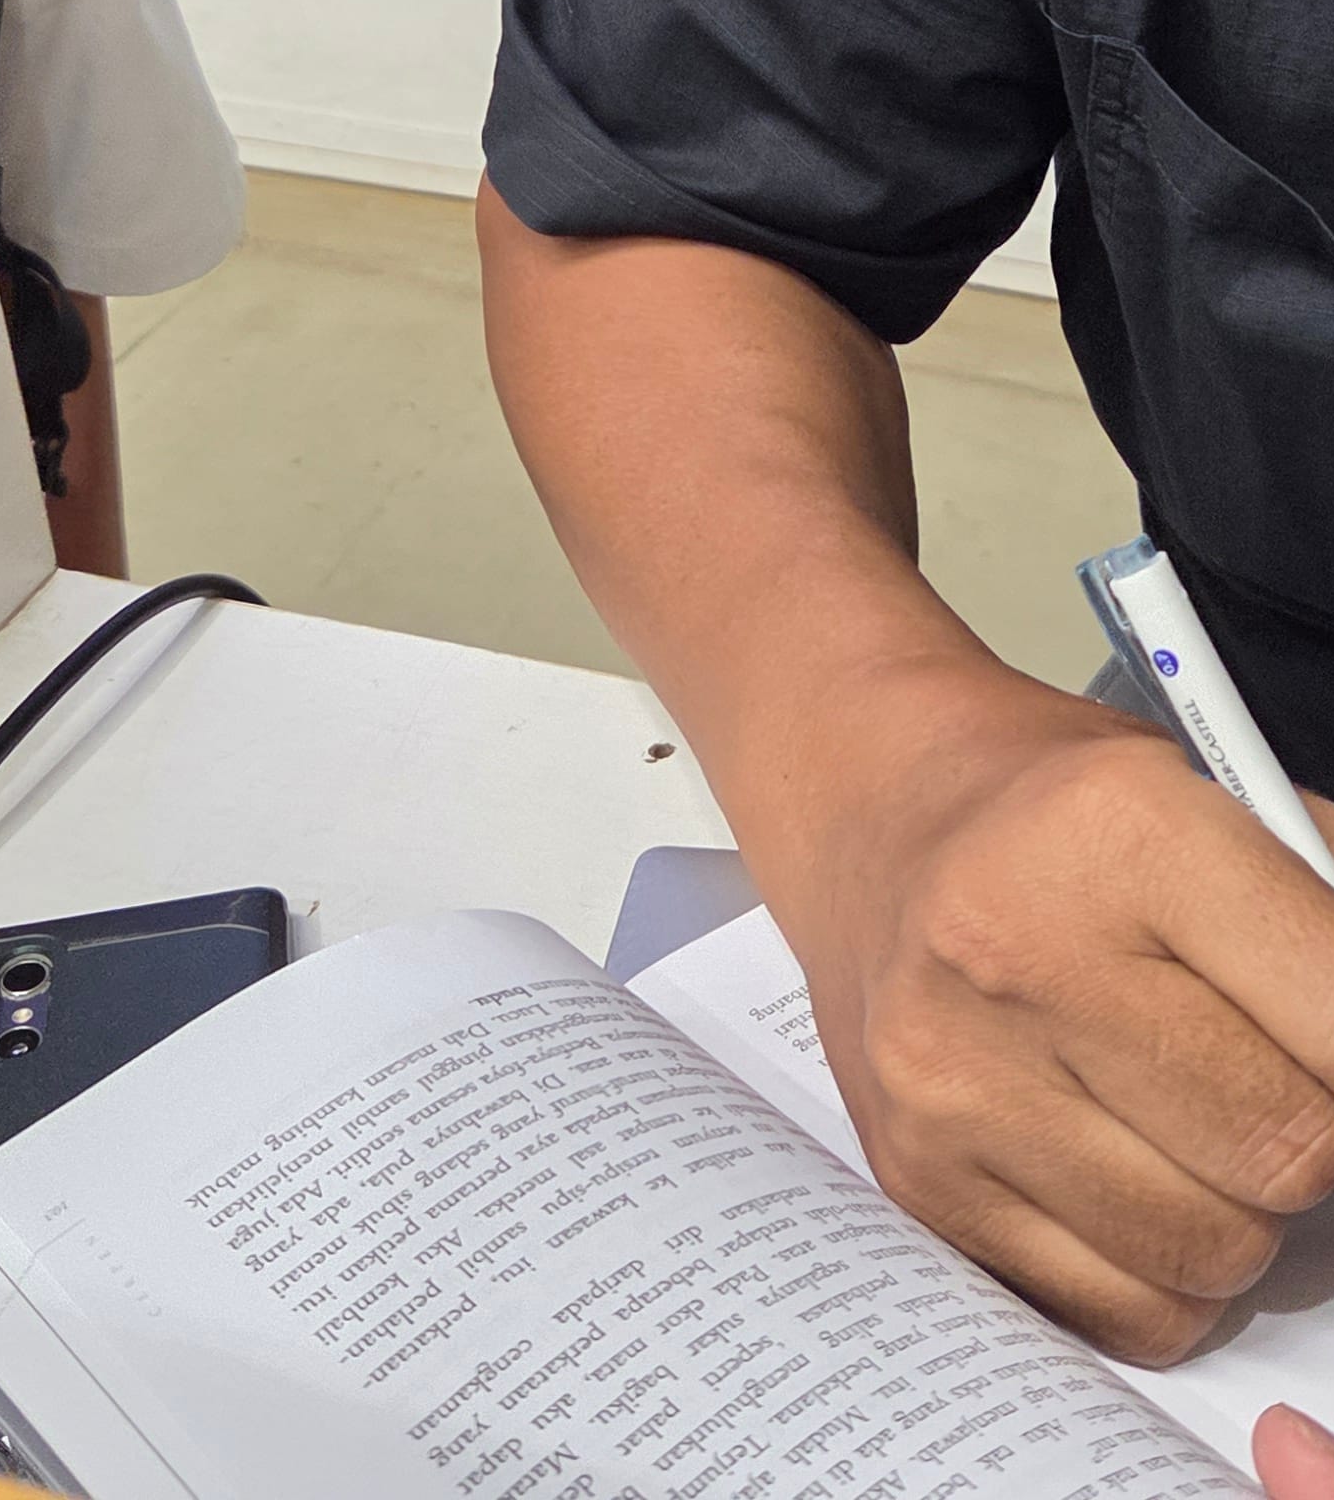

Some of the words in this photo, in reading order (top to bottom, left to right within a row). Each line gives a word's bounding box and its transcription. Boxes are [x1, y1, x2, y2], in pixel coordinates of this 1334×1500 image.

[468, 986, 533, 1007] budu.
[490, 1003, 551, 1023] Lucu.
[441, 1022, 491, 1047] Dah
[363, 1043, 438, 1087] macam
[416, 1042, 493, 1093] pinggul
[479, 1037, 603, 1084] Berfoya-foya
[405, 1082, 478, 1126] sesama
[531, 1073, 567, 1093] Di
[549, 1070, 666, 1119] huruf-huruf
[264, 1087, 365, 1151] kambing
[341, 1088, 410, 1140] sambil
[422, 1089, 530, 1149] bawahnya
[490, 1105, 546, 1141] yang
[563, 1101, 639, 1135] kepada
[616, 1113, 685, 1142] tempat
[692, 1106, 722, 1120] ke
[326, 1124, 405, 1180] sendiri.
[515, 1133, 560, 1162] ayat
[567, 1141, 607, 1170] asal
[671, 1125, 741, 1148] senyum
[184, 1152, 263, 1209] mabuk
[359, 1148, 415, 1188] pula,
[414, 1139, 490, 1188] sedang
[541, 1149, 660, 1215] tersipu-sipu
[644, 1173, 678, 1191] ke
[683, 1147, 754, 1174] melihat
[207, 1137, 333, 1228] menjelirkan
[276, 1178, 323, 1214] Ada
[424, 1155, 512, 1219] pertama
[474, 1167, 557, 1218] mereka.
[720, 1186, 811, 1220] melarikan
[226, 1207, 280, 1250] juga
[309, 1196, 351, 1226] ada
[351, 1189, 413, 1235] sibuk
[545, 1193, 639, 1249] kawasan
[244, 1225, 304, 1273] yang
[337, 1216, 421, 1282] petikan
[413, 1227, 463, 1265] Aku
[455, 1221, 528, 1279] sambil
[663, 1225, 704, 1254] diri
[716, 1217, 798, 1257] terdapat
[771, 1240, 817, 1262] atas.
[822, 1223, 901, 1243] bahagian
[269, 1235, 347, 1299] menari
[490, 1256, 537, 1283] itu,
[711, 1264, 770, 1296] Pada
[756, 1260, 850, 1307] segalanya
[291, 1284, 338, 1313] itu.
[314, 1272, 409, 1346] kembali
[552, 1260, 645, 1324] daripada
[613, 1258, 716, 1321] beberapa
[796, 1270, 898, 1323] peribahasa
[894, 1290, 964, 1317] Setelah
[340, 1277, 442, 1363] perlahan-
[655, 1299, 705, 1335] ekor
[686, 1313, 745, 1357] sukar
[818, 1314, 883, 1349] saling
[364, 1292, 477, 1388] perkataan-
[584, 1337, 648, 1382] mata,
[873, 1324, 930, 1358] yang
[916, 1336, 990, 1376] petikan
[498, 1321, 606, 1410] perkataan
[948, 1375, 992, 1399] teks
[407, 1339, 532, 1440] cengkaman
[588, 1365, 679, 1424] bagiku.
[768, 1357, 882, 1424] berkelana.
[870, 1376, 911, 1399] itu.
[1021, 1385, 1060, 1404] lagi
[530, 1393, 576, 1430] aku
[615, 1396, 681, 1456] pahat
[653, 1354, 809, 1471] menghulurkan
[891, 1390, 951, 1430] yang
[1020, 1418, 1068, 1443] Aku
[428, 1412, 491, 1467] yang
[782, 1405, 870, 1465] Mudah
[853, 1427, 896, 1458] ada
[909, 1401, 1018, 1464] menjawab.
[457, 1438, 523, 1495] dapat
[825, 1459, 854, 1481] di
[975, 1445, 1015, 1471] tak
